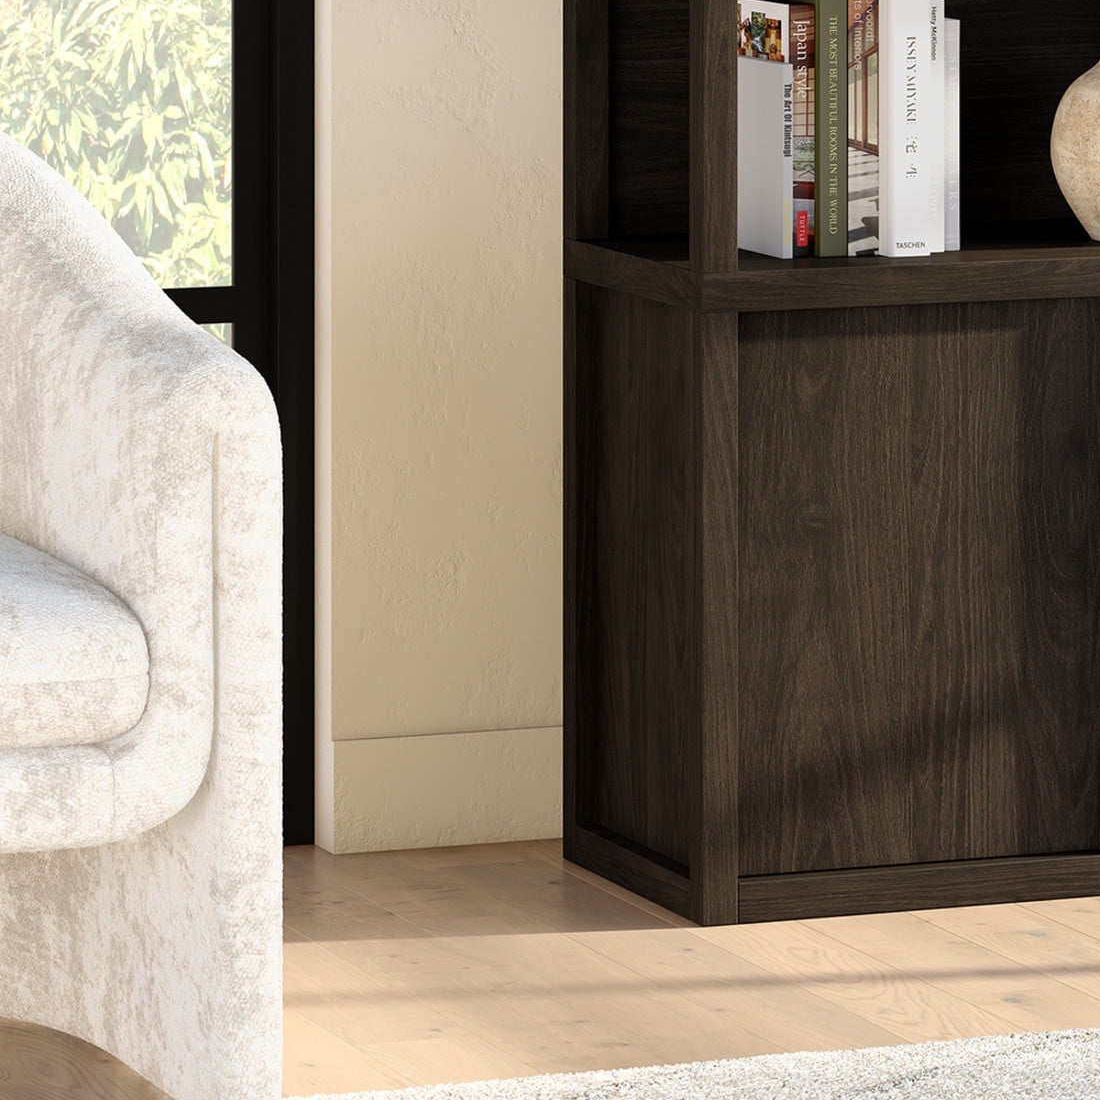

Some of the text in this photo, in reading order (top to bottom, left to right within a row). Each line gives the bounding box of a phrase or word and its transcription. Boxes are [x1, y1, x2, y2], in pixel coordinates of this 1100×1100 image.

[854, 13, 863, 23] of
[929, 6, 938, 61] Hetty McKinnon
[793, 20, 811, 99] Japan style
[854, 27, 863, 70] Interiors
[783, 84, 792, 98] The
[783, 100, 792, 112] Art
[829, 15, 838, 234] THE MOST BEAUTIFUL ROOMS IN THE WORLD
[783, 125, 792, 157] Kintsugi
[896, 241, 926, 249] TASCHEN
